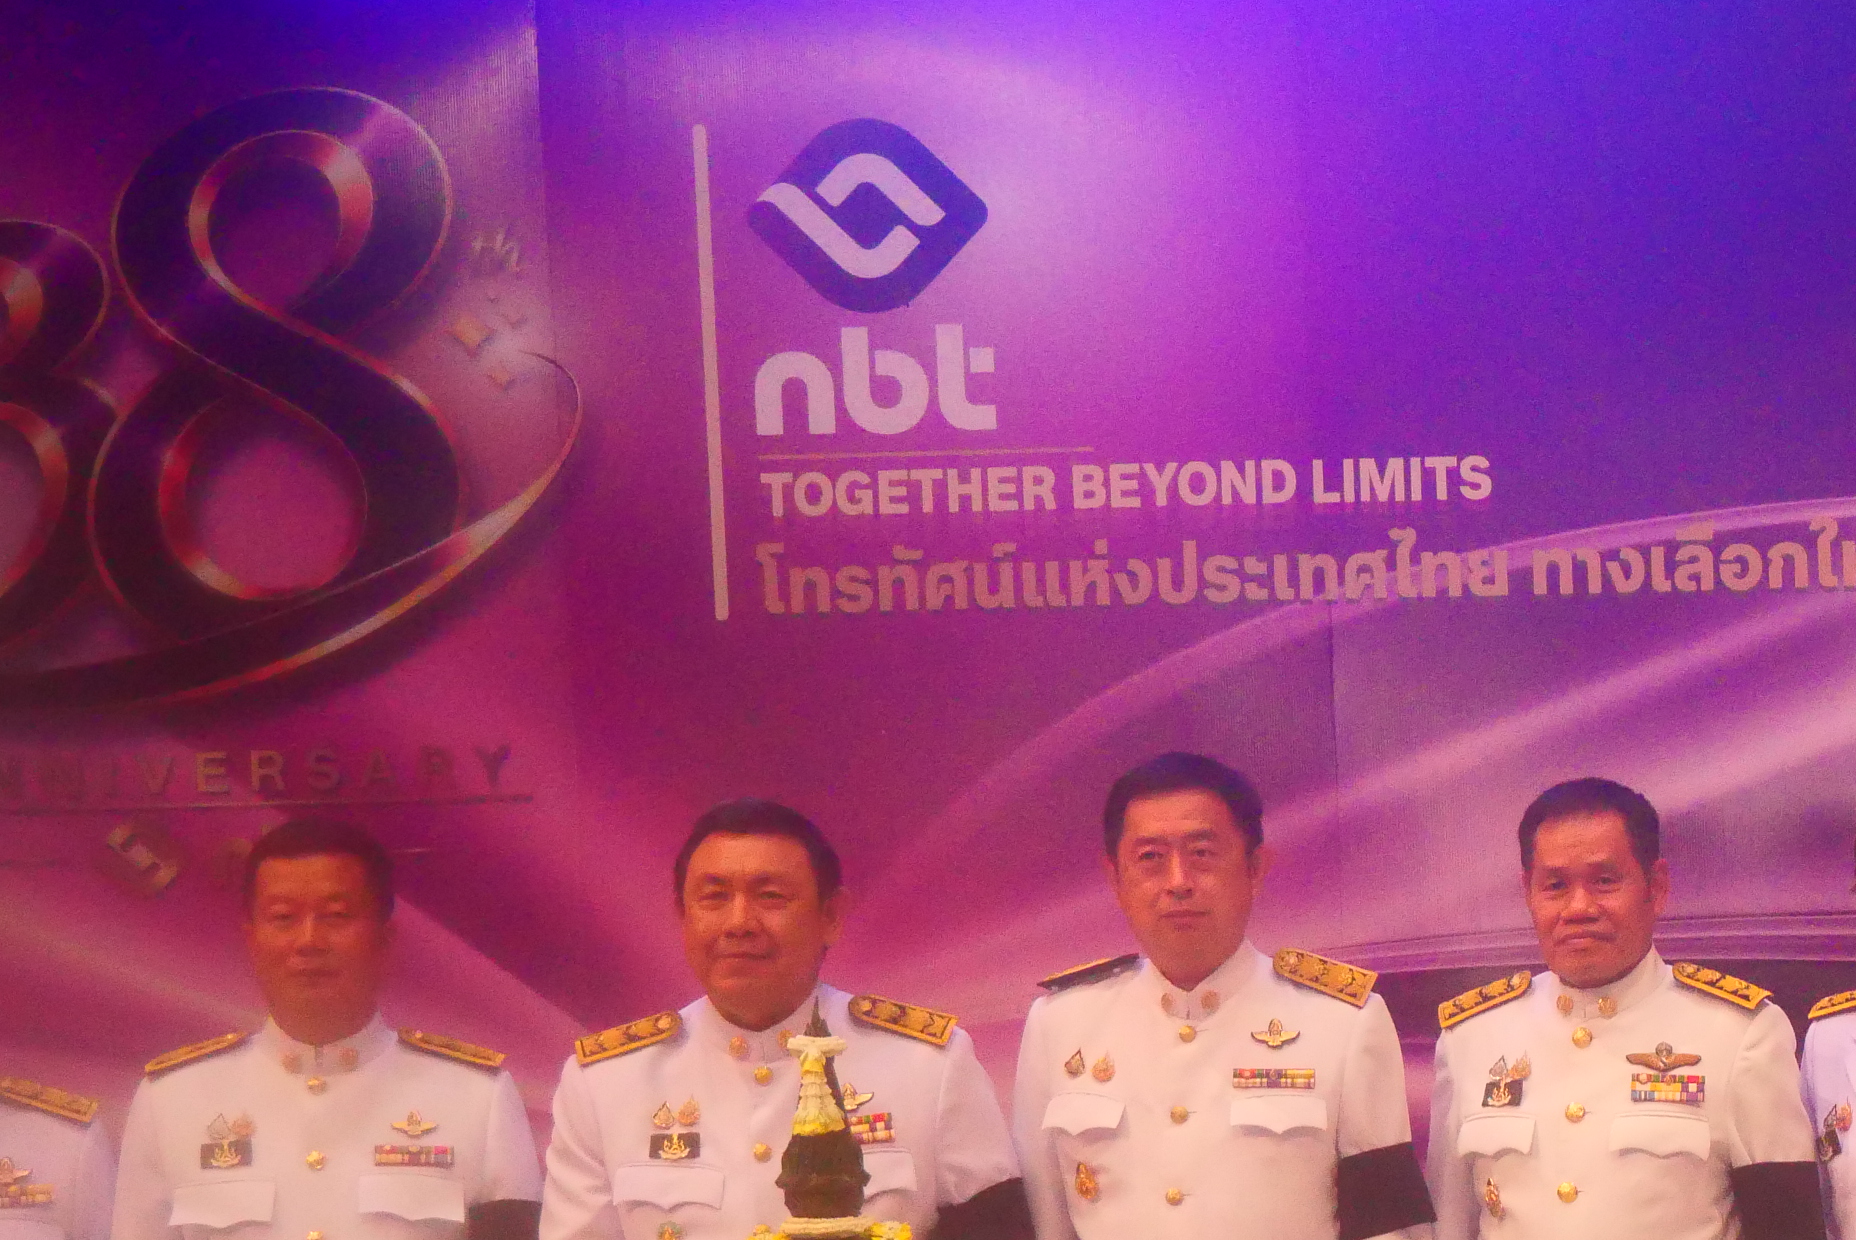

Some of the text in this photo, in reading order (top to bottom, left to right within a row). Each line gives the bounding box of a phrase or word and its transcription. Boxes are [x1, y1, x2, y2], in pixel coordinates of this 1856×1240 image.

[754, 323, 997, 436] nbt
[760, 455, 1494, 517] TOGETHER BEYOND LIMITS
[755, 527, 1510, 615] โทรทัศน์แห่งประเทศไทย
